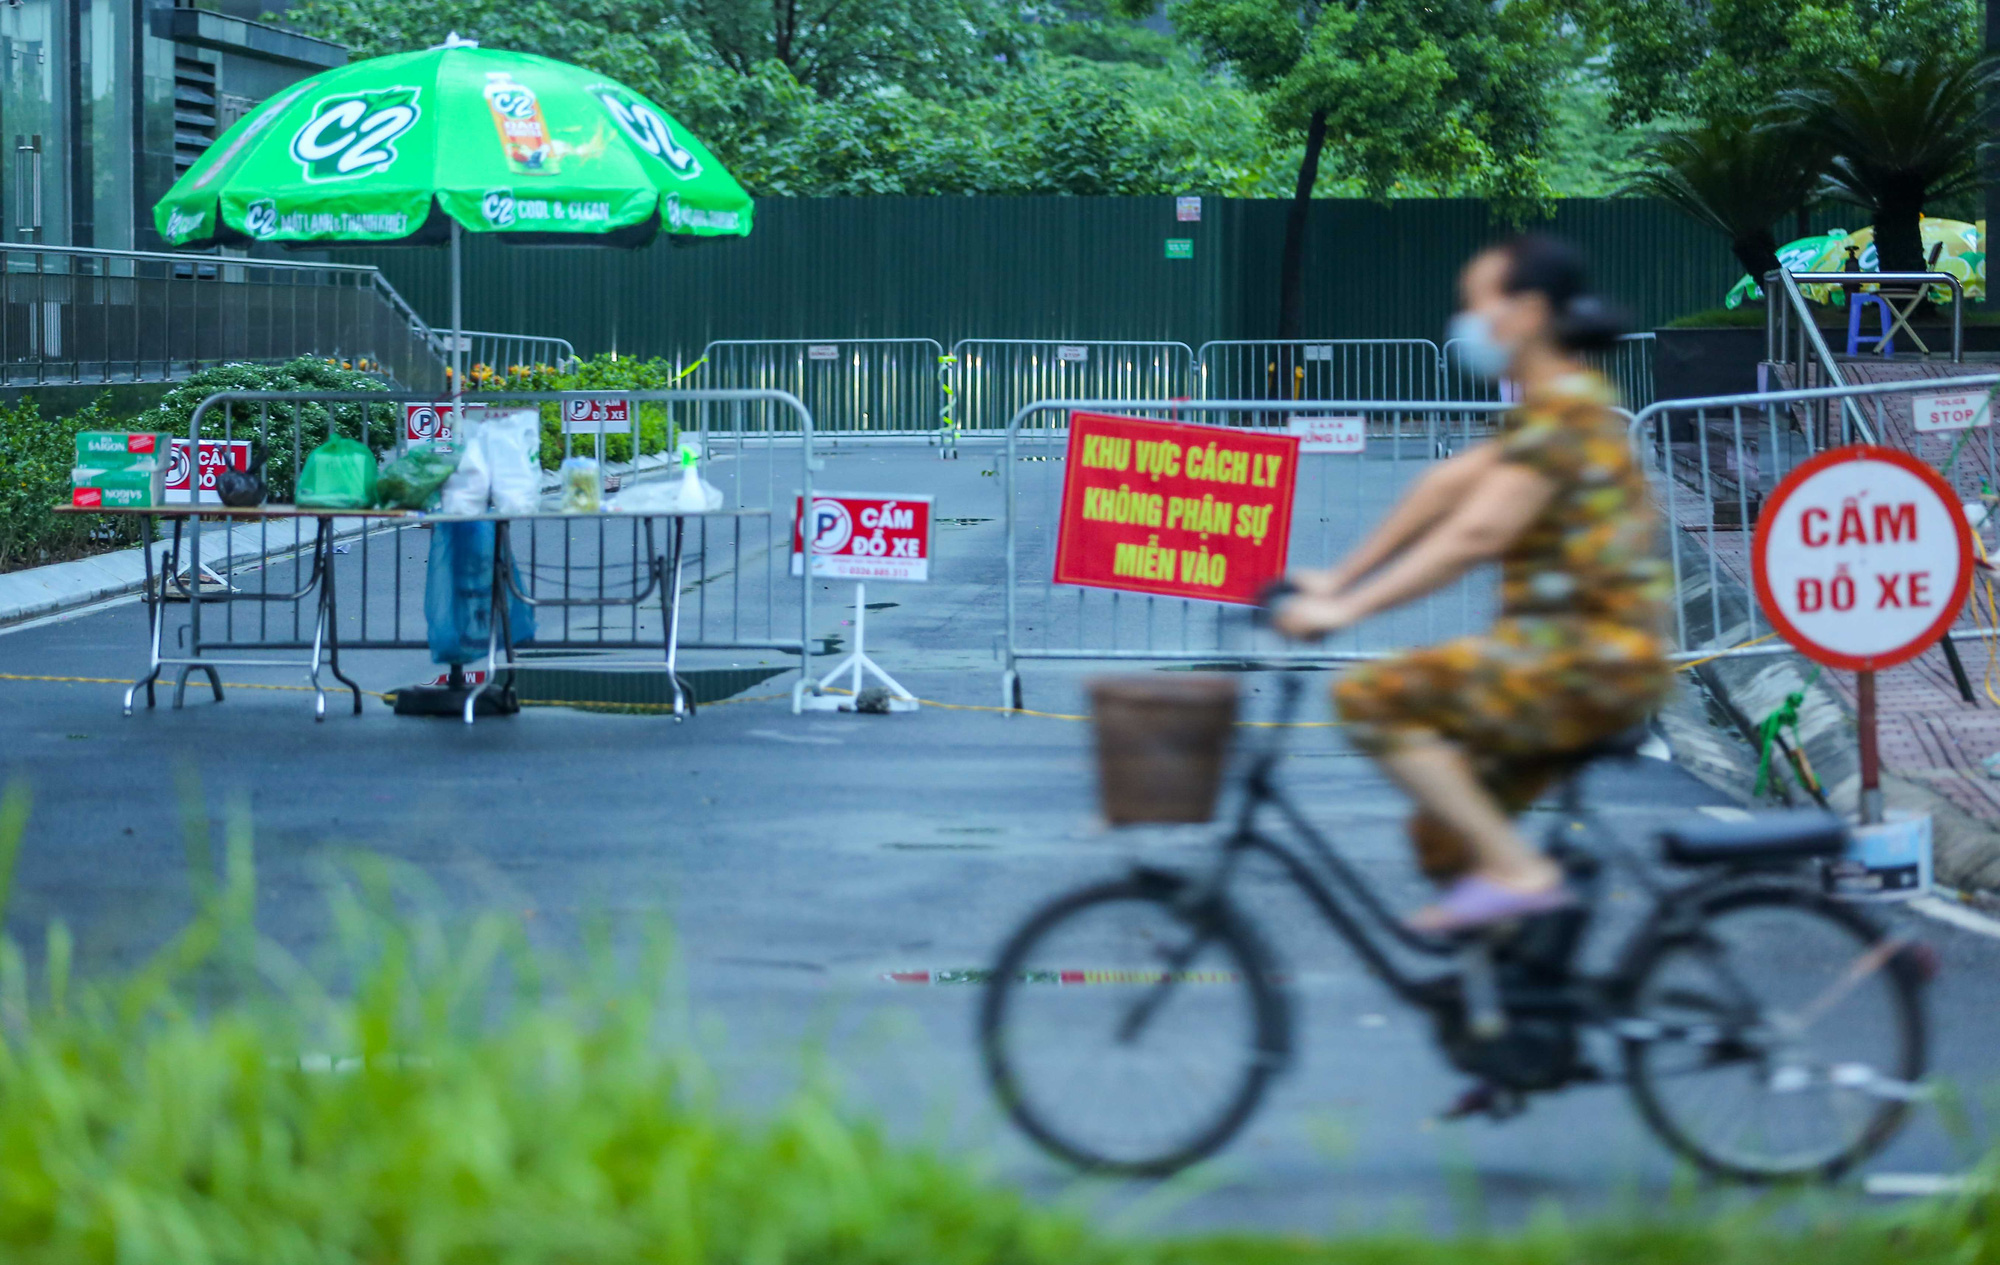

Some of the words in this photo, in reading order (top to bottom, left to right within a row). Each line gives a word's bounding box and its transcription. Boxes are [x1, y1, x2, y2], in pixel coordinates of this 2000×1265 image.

[493, 92, 536, 117] C2
[296, 100, 414, 174] C2
[600, 94, 692, 171] C2
[246, 206, 278, 235] C2
[484, 194, 514, 222] C2
[517, 200, 550, 219] COOL
[553, 201, 565, 219] &
[568, 203, 609, 220] CLEAN
[611, 410, 625, 420] XE
[1930, 409, 1974, 424] STOP
[88, 441, 126, 452] SAIGON
[1082, 434, 1131, 472] KHU
[1135, 439, 1182, 482] VỰC
[1185, 441, 1249, 485] CÁCH
[1251, 453, 1283, 488] LY
[859, 500, 914, 529] CẤM
[1082, 484, 1164, 528] KHÔNG
[1166, 493, 1233, 540] PHẬN
[1235, 504, 1274, 546] SỰ
[1799, 489, 1918, 548] CẤM
[851, 529, 887, 556] ĐỖ
[890, 537, 920, 558] XE
[1113, 534, 1176, 582] MIỄN
[1180, 545, 1227, 587] VÀO
[1796, 562, 1856, 613] ĐỖ
[1875, 571, 1931, 610] XE
